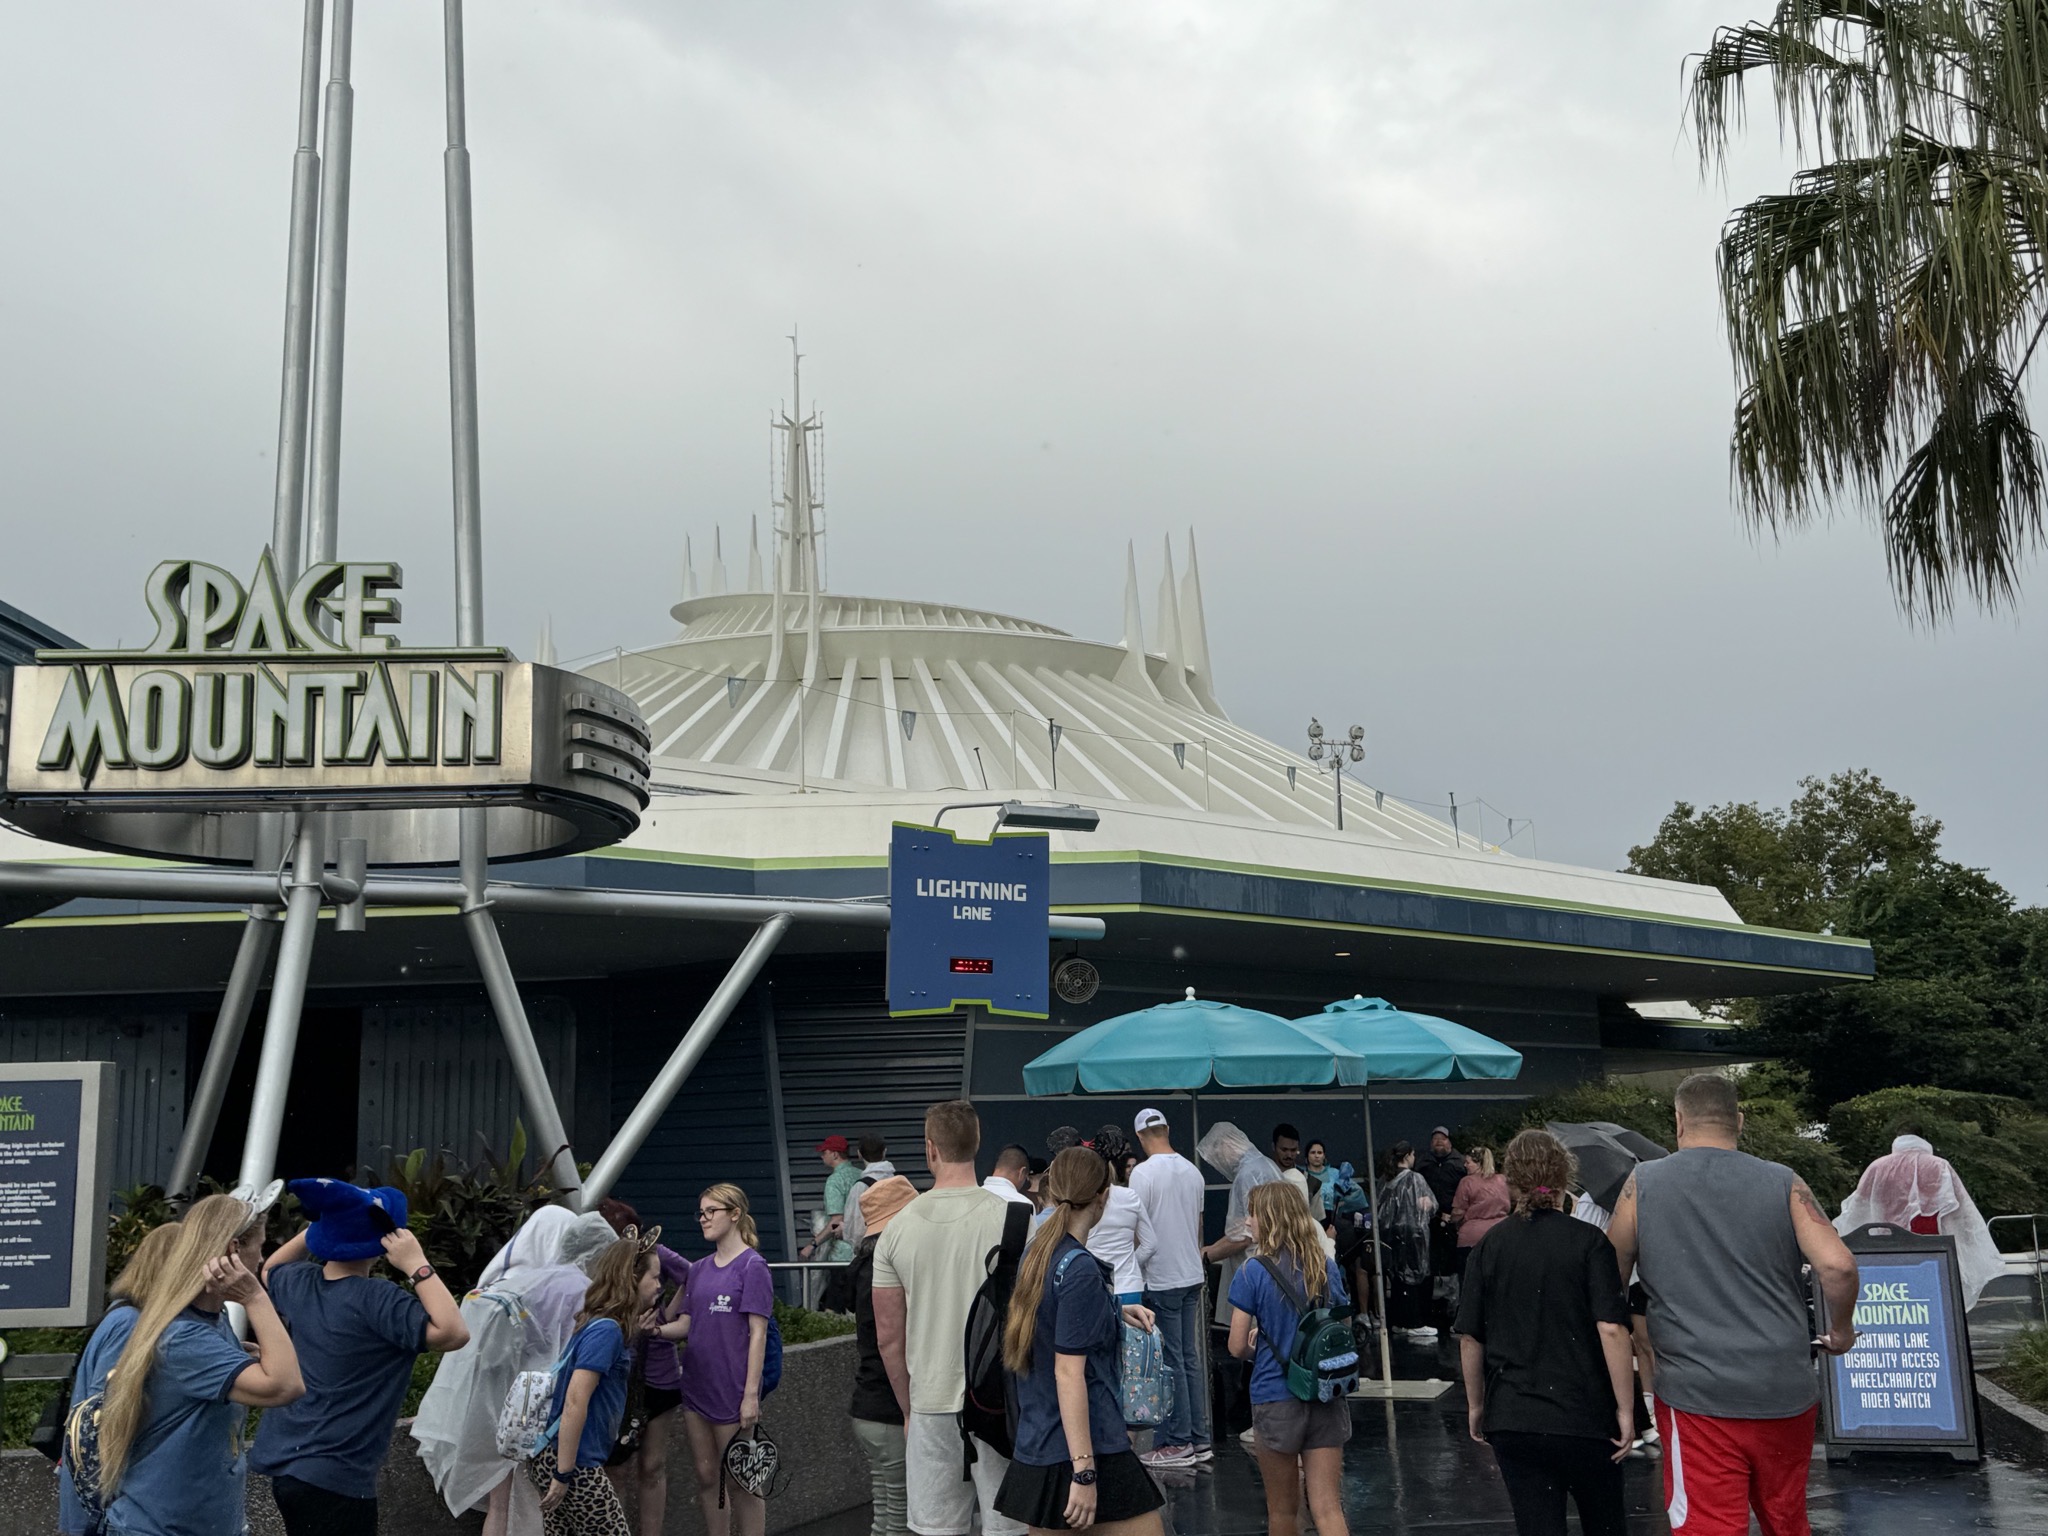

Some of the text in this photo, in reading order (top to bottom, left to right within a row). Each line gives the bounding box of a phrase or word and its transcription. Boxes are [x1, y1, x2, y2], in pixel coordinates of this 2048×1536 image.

[145, 543, 402, 653] SPACE
[37, 661, 501, 790] MOUNTAIN
[916, 878, 1027, 902] LIGHTNING
[953, 905, 992, 921] LANE
[0, 1095, 23, 1112] ACE
[1863, 1281, 1909, 1301] SPACE
[1903, 1332, 1931, 1349] LANE
[1844, 1352, 1940, 1369] DISABILITY ACCESS
[1850, 1372, 1937, 1389] WHEELCHAIR/ECV
[1861, 1392, 1932, 1409] RIDER SWITCH
[742, 1445, 767, 1473] LOVE
[749, 1466, 769, 1491] END
